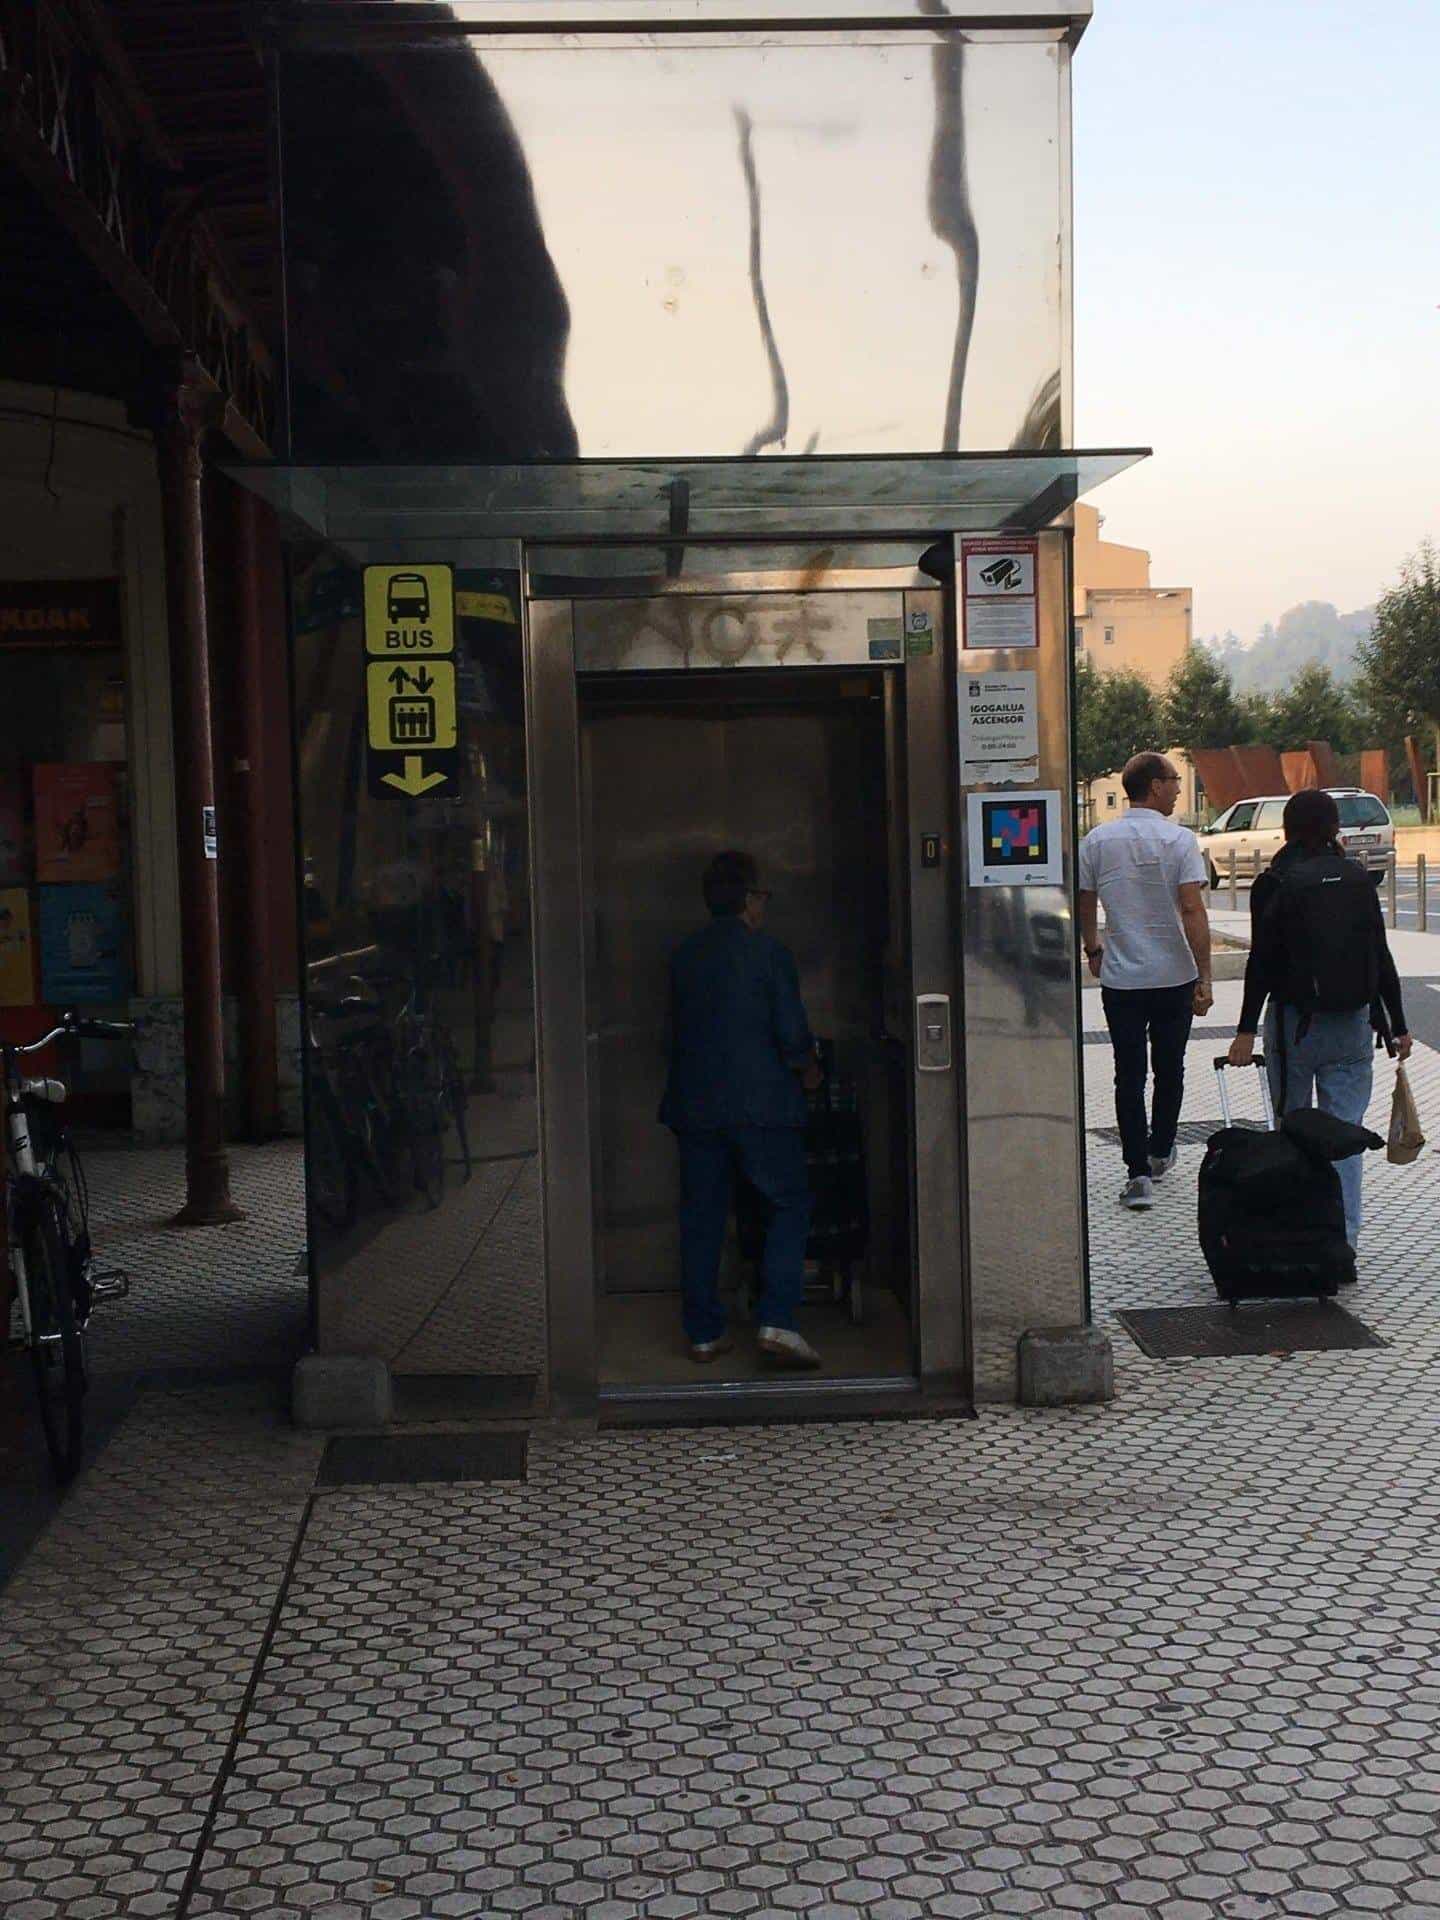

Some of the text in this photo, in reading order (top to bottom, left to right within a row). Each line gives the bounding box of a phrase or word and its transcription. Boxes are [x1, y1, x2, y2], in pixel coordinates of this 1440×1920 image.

[385, 630, 433, 648] BUS
[970, 704, 1024, 713] IGOGAILUA
[972, 715, 1024, 725] ASCENSOR
[926, 839, 935, 859] 0
